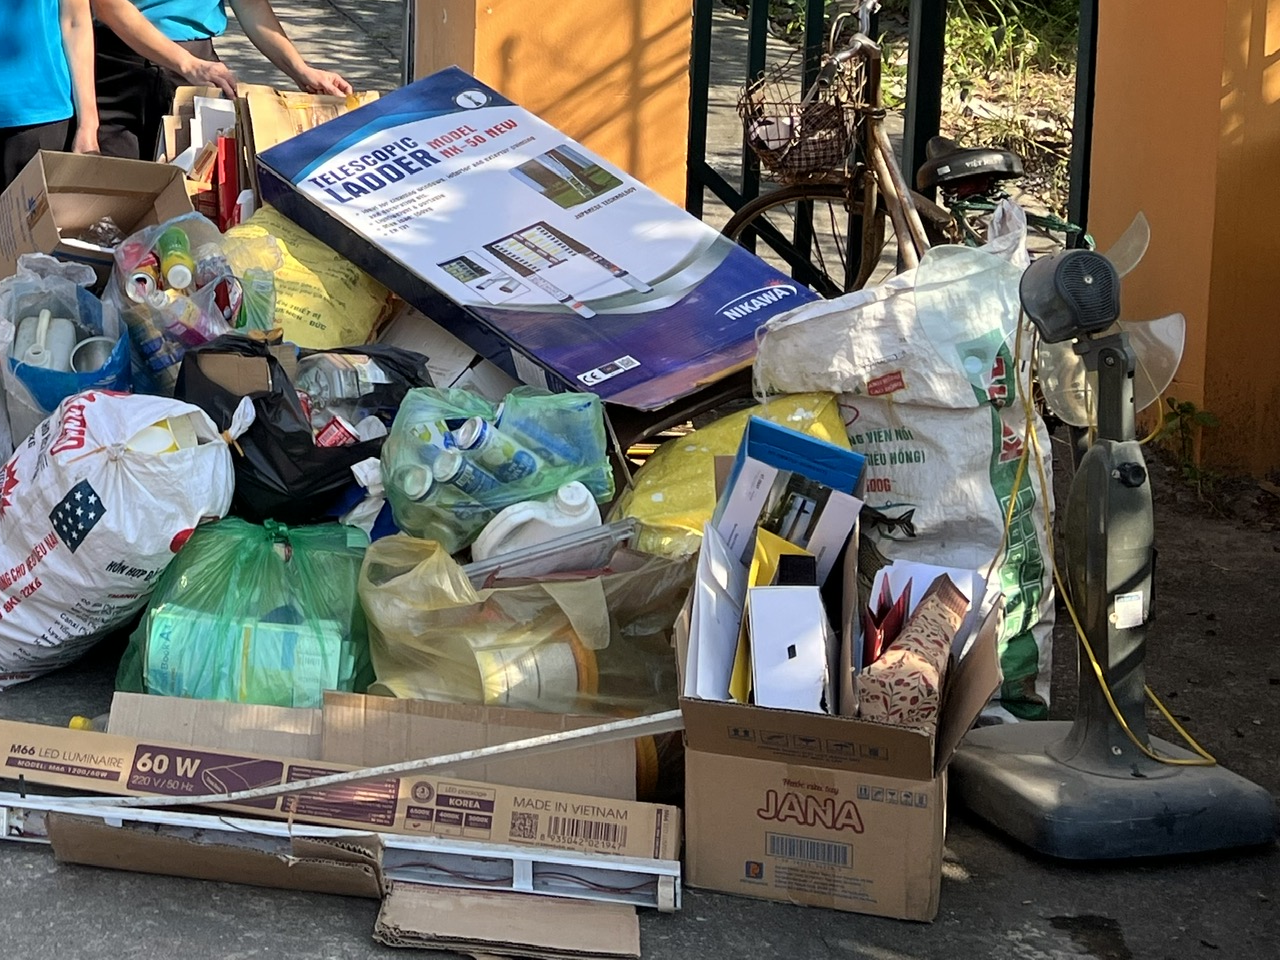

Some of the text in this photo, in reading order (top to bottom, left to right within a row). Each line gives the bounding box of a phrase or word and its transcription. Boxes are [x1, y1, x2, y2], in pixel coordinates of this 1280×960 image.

[426, 124, 478, 150] MODEL
[484, 119, 518, 139] NEW
[308, 136, 419, 188] TELESCOPIC
[323, 148, 441, 204] LADDER
[723, 288, 790, 320] NIKAWA
[7, 561, 29, 583] CHO
[10, 744, 124, 768] M66 LED LUMINAIRE
[136, 752, 201, 778] 60 W
[17, 760, 108, 778] MODEL: M66 1200/60W
[132, 775, 150, 786] 220
[181, 781, 194, 792] Hz
[449, 798, 481, 809] KOREA
[513, 797, 628, 821] MADE IN VIETNAM
[757, 789, 864, 834] JANA
